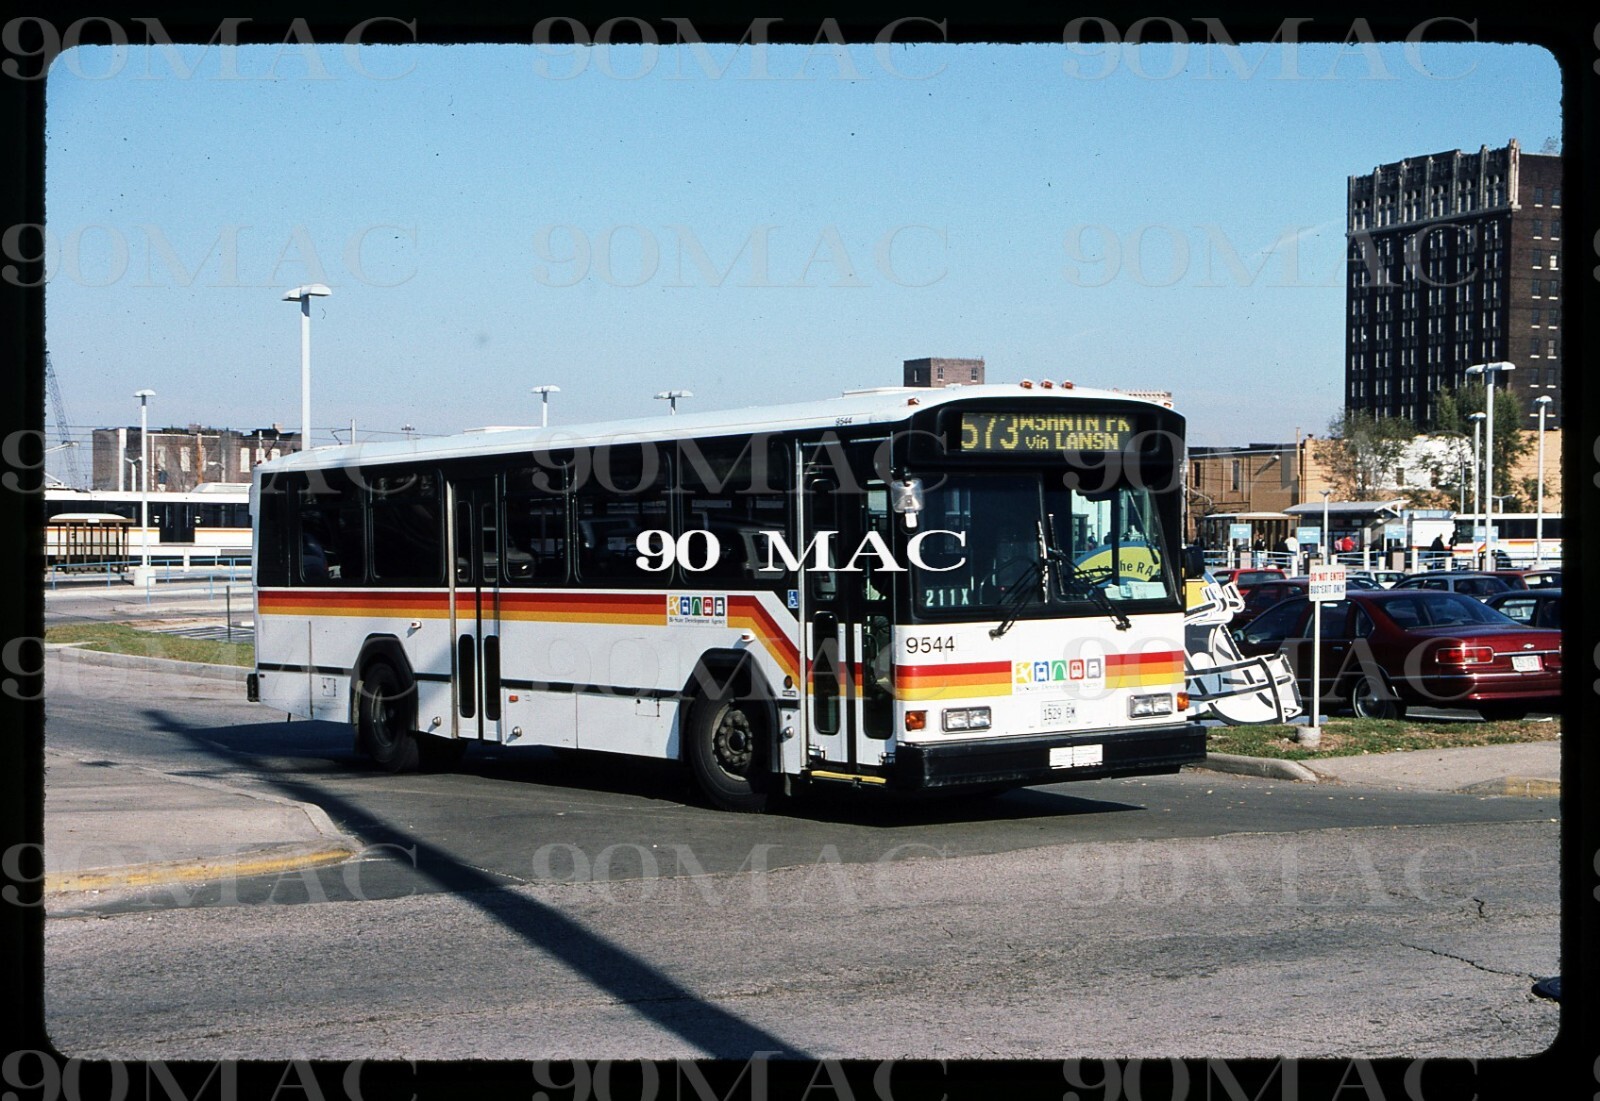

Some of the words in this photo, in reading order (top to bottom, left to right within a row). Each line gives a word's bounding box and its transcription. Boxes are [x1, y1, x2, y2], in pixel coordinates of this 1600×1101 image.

[961, 414, 1018, 449] 573
[1055, 432, 1119, 450] LANSN
[1118, 560, 1134, 572] he
[1311, 573, 1317, 581] DO
[1318, 572, 1328, 581] NOT
[1330, 572, 1344, 581] ENTER
[1311, 585, 1319, 594] BUS
[1334, 585, 1344, 593] ONLY
[925, 588, 970, 607] 211X
[905, 635, 955, 655] 9544
[1043, 708, 1062, 721] 1529
